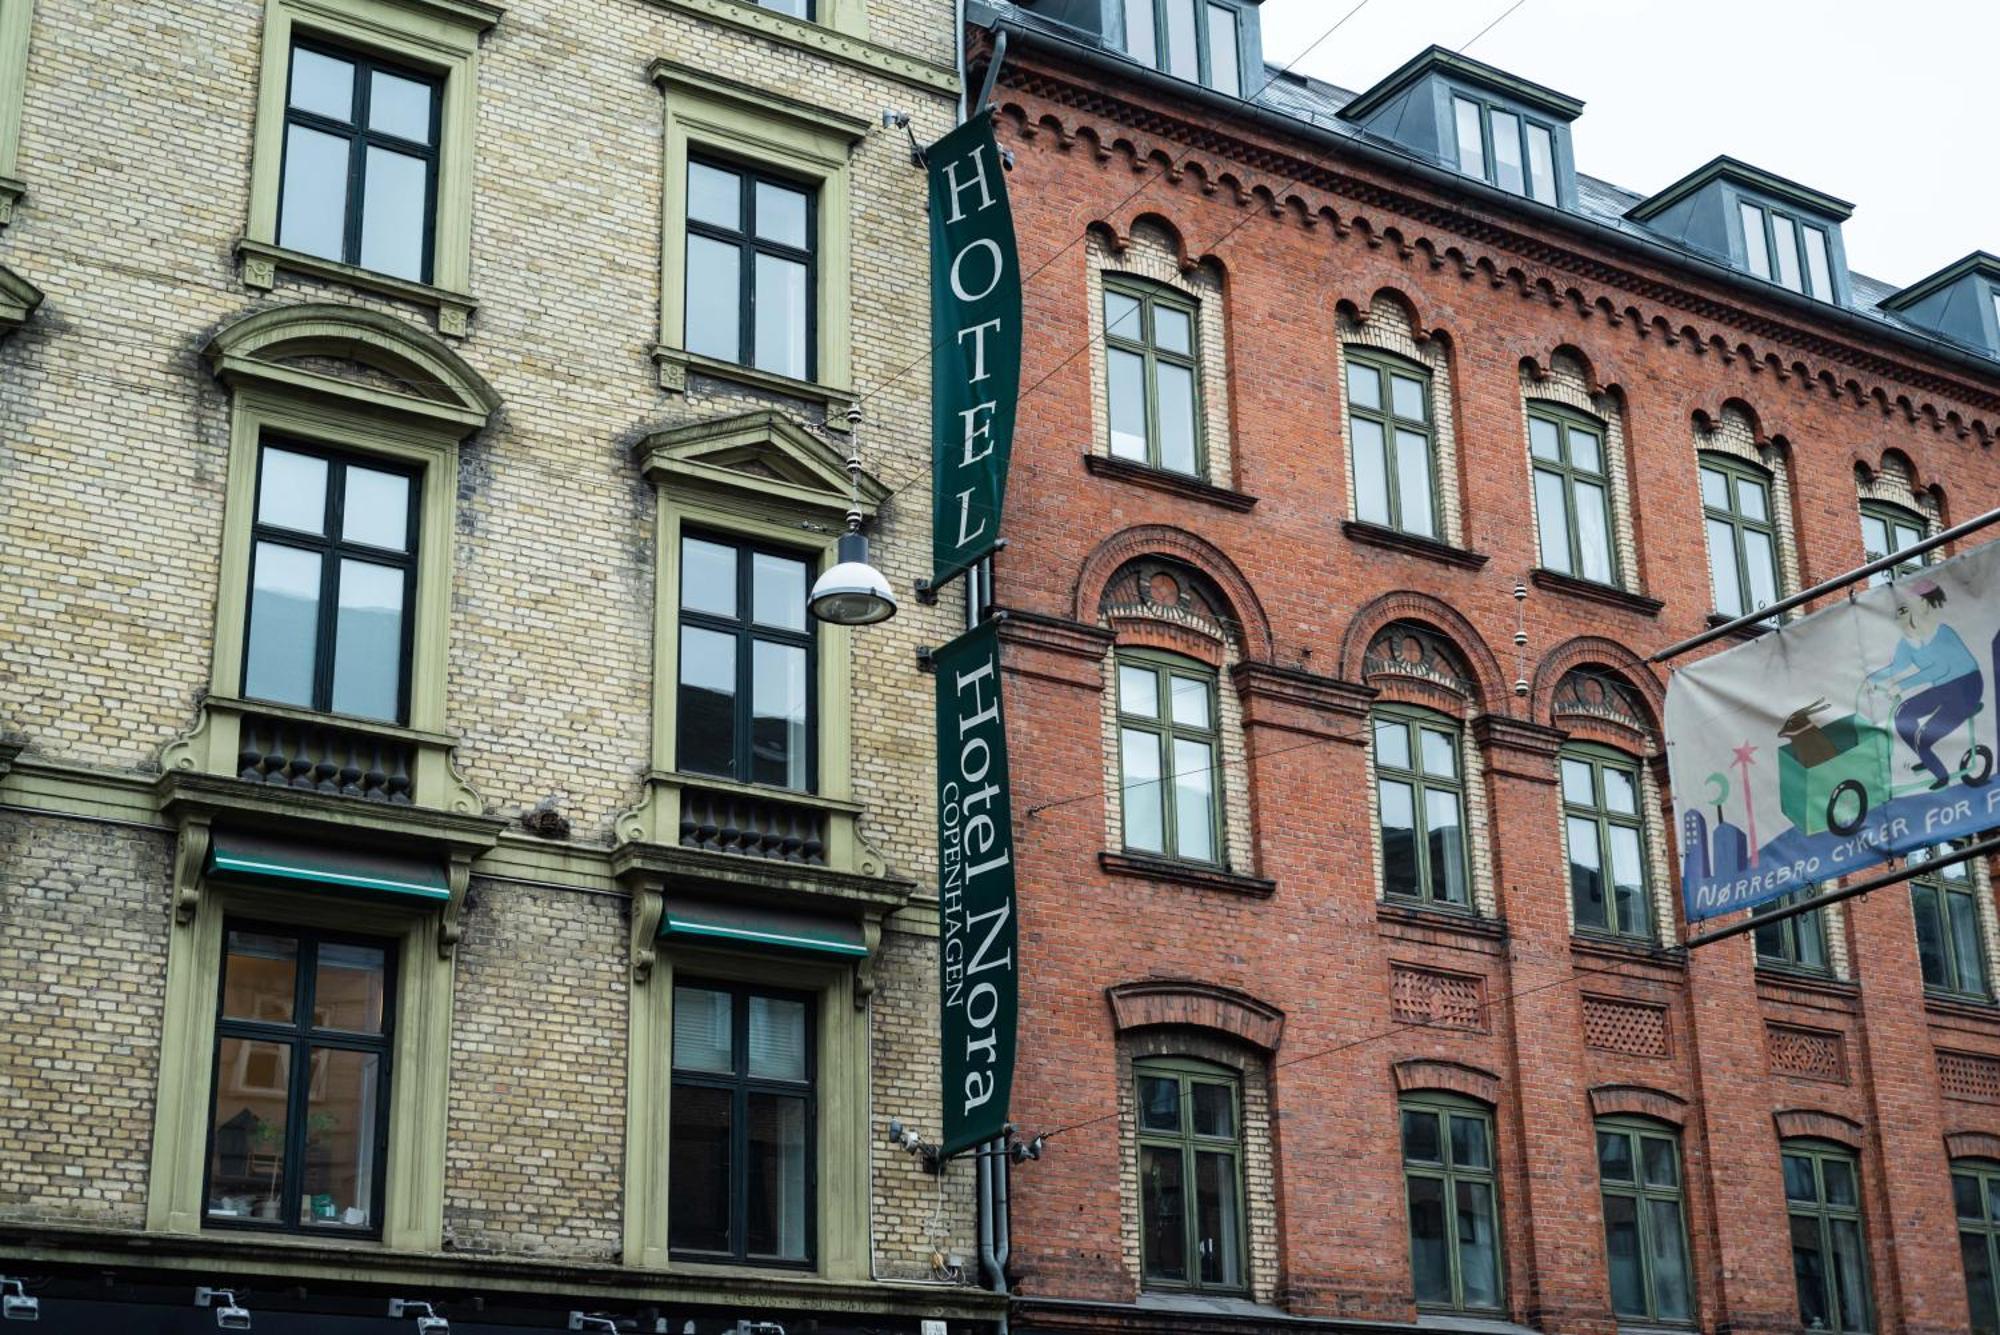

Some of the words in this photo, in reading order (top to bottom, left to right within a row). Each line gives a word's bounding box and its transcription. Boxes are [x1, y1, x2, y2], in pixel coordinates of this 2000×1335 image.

[942, 144, 1003, 548] HOTEL
[956, 653, 1010, 886] Hotel
[1696, 856, 1820, 910] NØRREBRO
[1831, 817, 1910, 863] CYKLER
[1924, 799, 1973, 834] FOR
[942, 781, 964, 1009] COPENHAGEN
[964, 896, 1012, 1117] Nora
